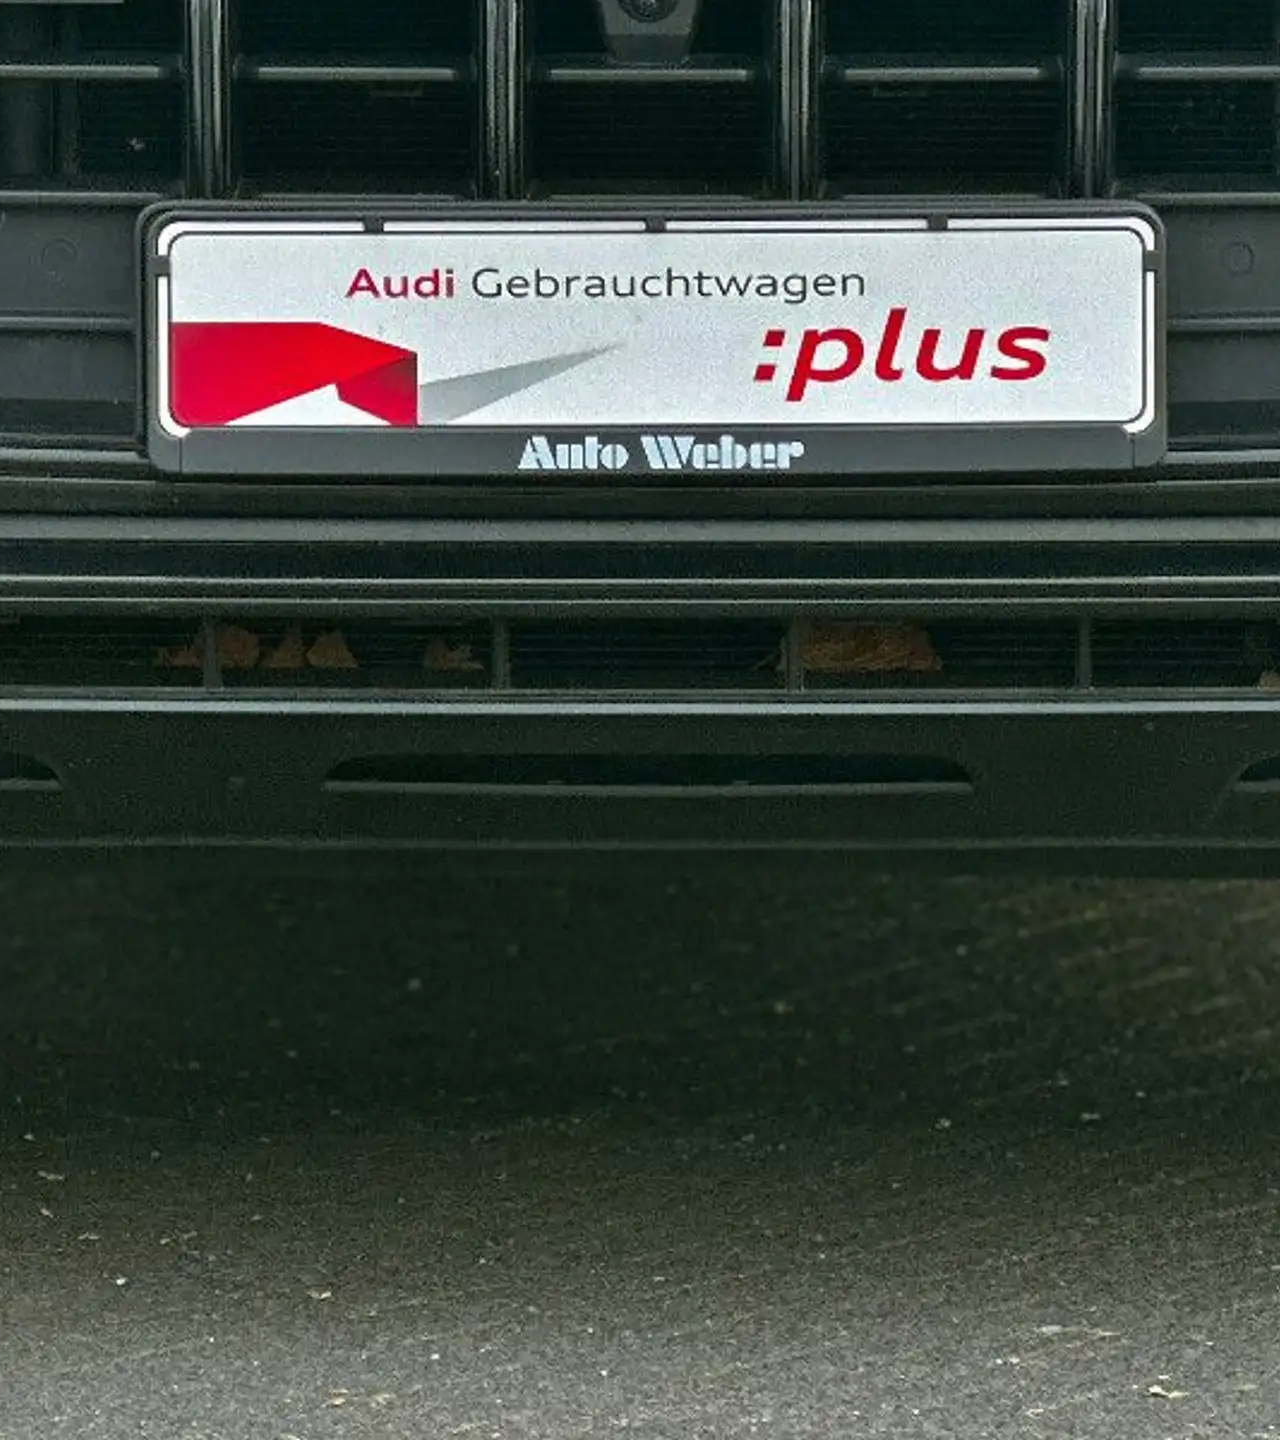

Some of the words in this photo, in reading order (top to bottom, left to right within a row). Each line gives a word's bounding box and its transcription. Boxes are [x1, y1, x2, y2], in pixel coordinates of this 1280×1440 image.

[346, 267, 455, 299] Audi
[471, 267, 866, 303] Gebrauchtwagen
[518, 435, 629, 471] Auto
[640, 435, 804, 471] Weber
